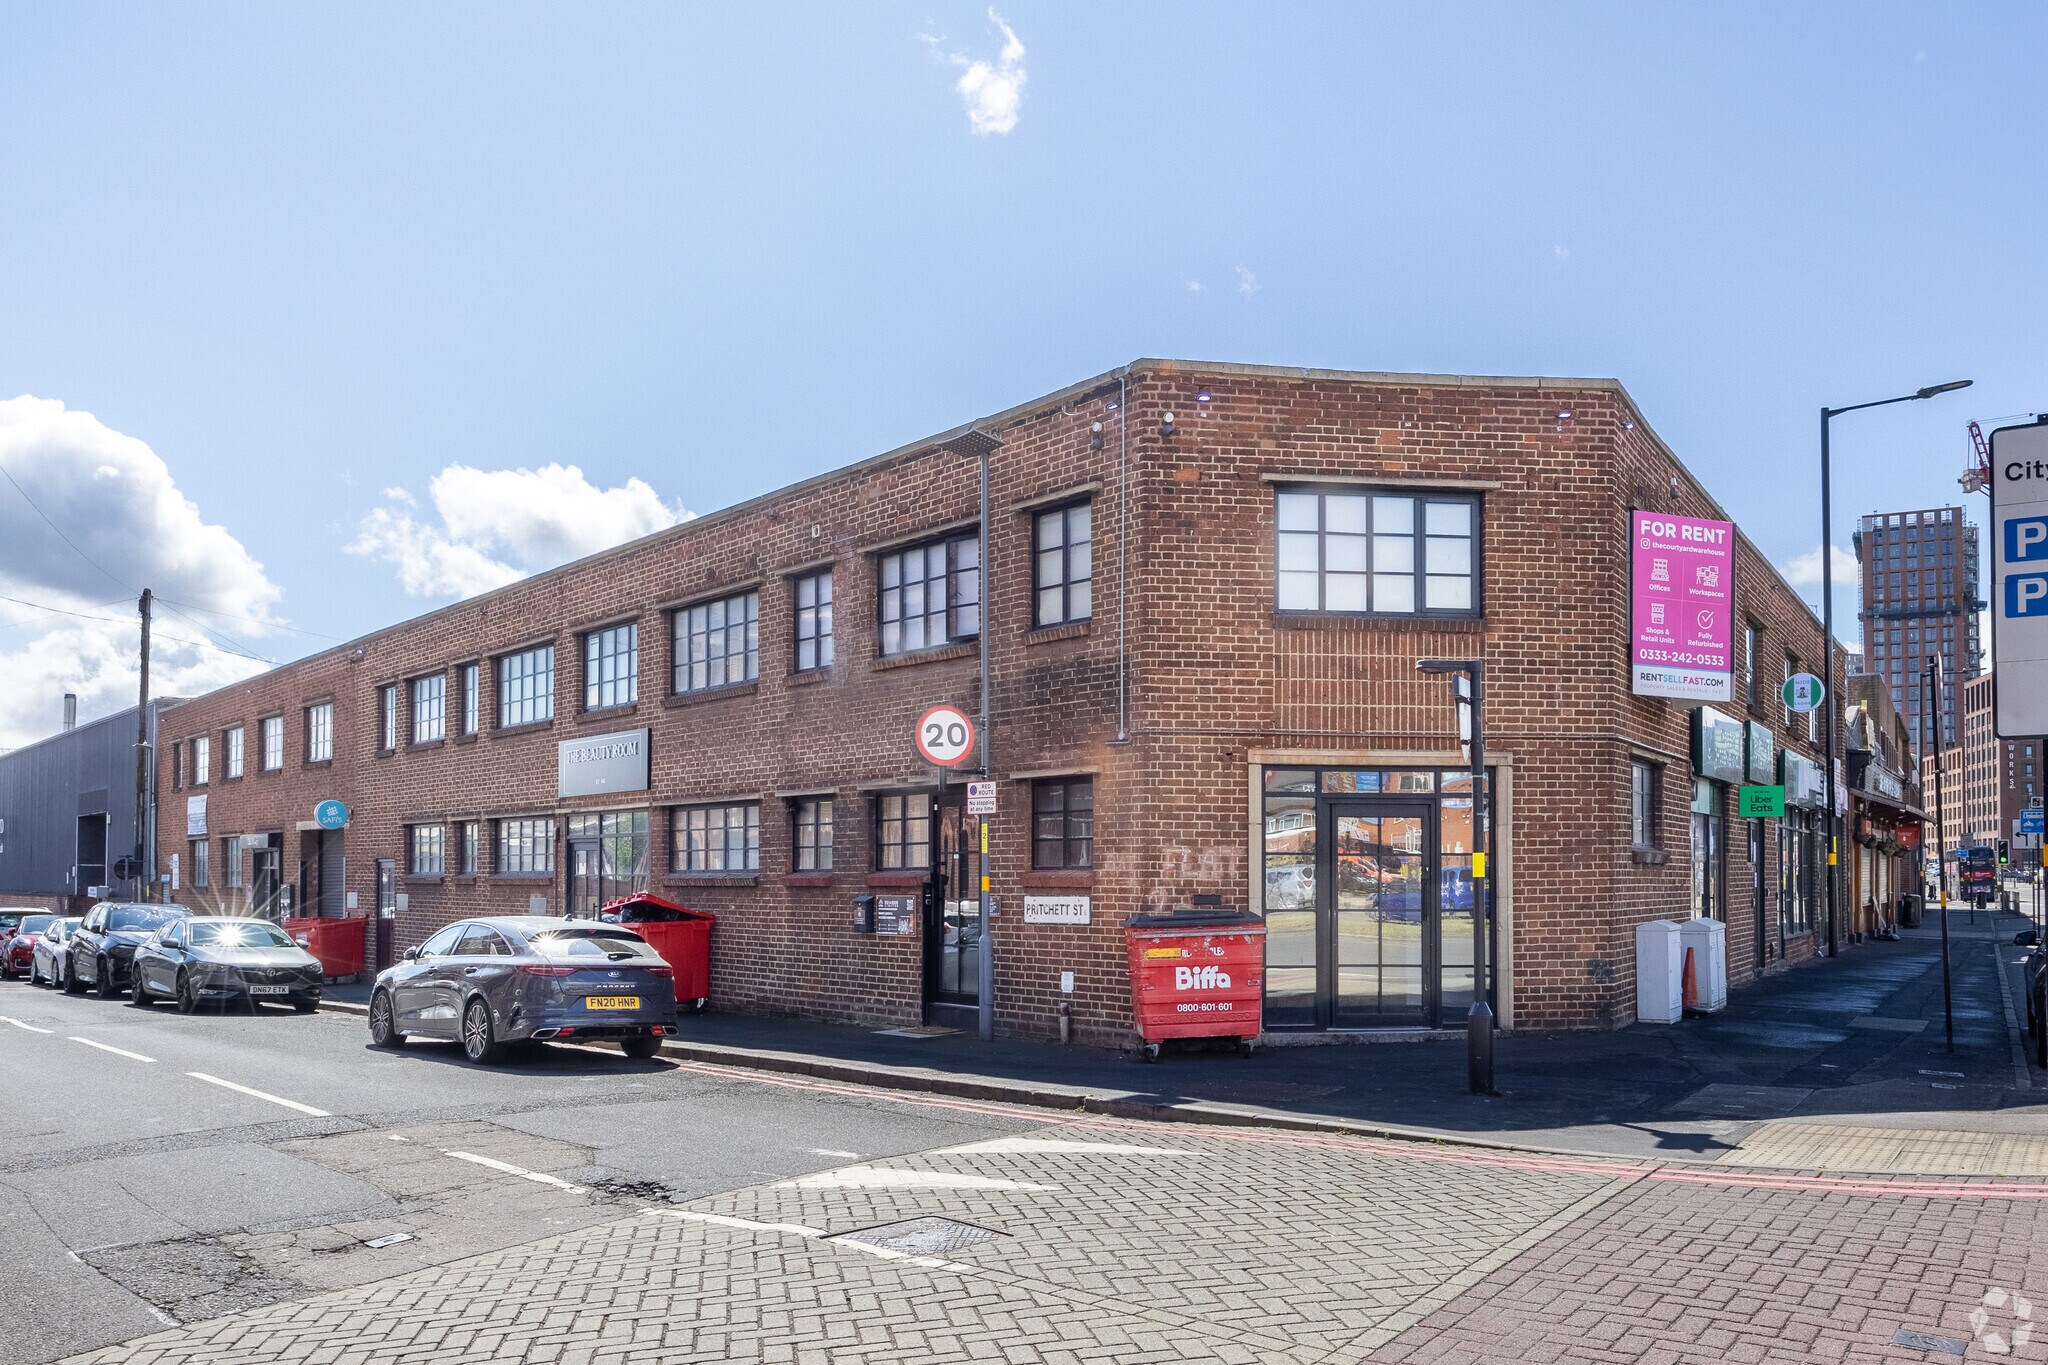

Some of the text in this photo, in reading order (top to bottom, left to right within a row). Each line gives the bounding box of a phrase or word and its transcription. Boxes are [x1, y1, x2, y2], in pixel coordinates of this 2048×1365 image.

[2005, 460, 2048, 481] Cit
[1641, 520, 1725, 544] FOR RENT
[2017, 521, 2047, 557] P
[1652, 542, 1725, 556] thecourtyardwarehouse
[1649, 584, 1670, 592] Offices
[1689, 588, 1724, 598] Workspaces
[2017, 577, 2047, 613] P
[1645, 627, 1664, 635] Shops
[1698, 632, 1712, 640] Fully
[1688, 640, 1724, 648] Refurbished
[1639, 649, 1724, 666] 0333-242-0533
[1640, 672, 1724, 687] RENTSELLFAST.COM
[926, 723, 966, 747] 20
[566, 741, 639, 763] THE BEAUTY ROOM
[1751, 795, 1773, 803] Uber
[1751, 804, 1773, 812] Eats
[1026, 904, 1070, 915] PRITCHETT
[1175, 965, 1231, 990] Biffa
[590, 998, 636, 1007] FN20 HNR
